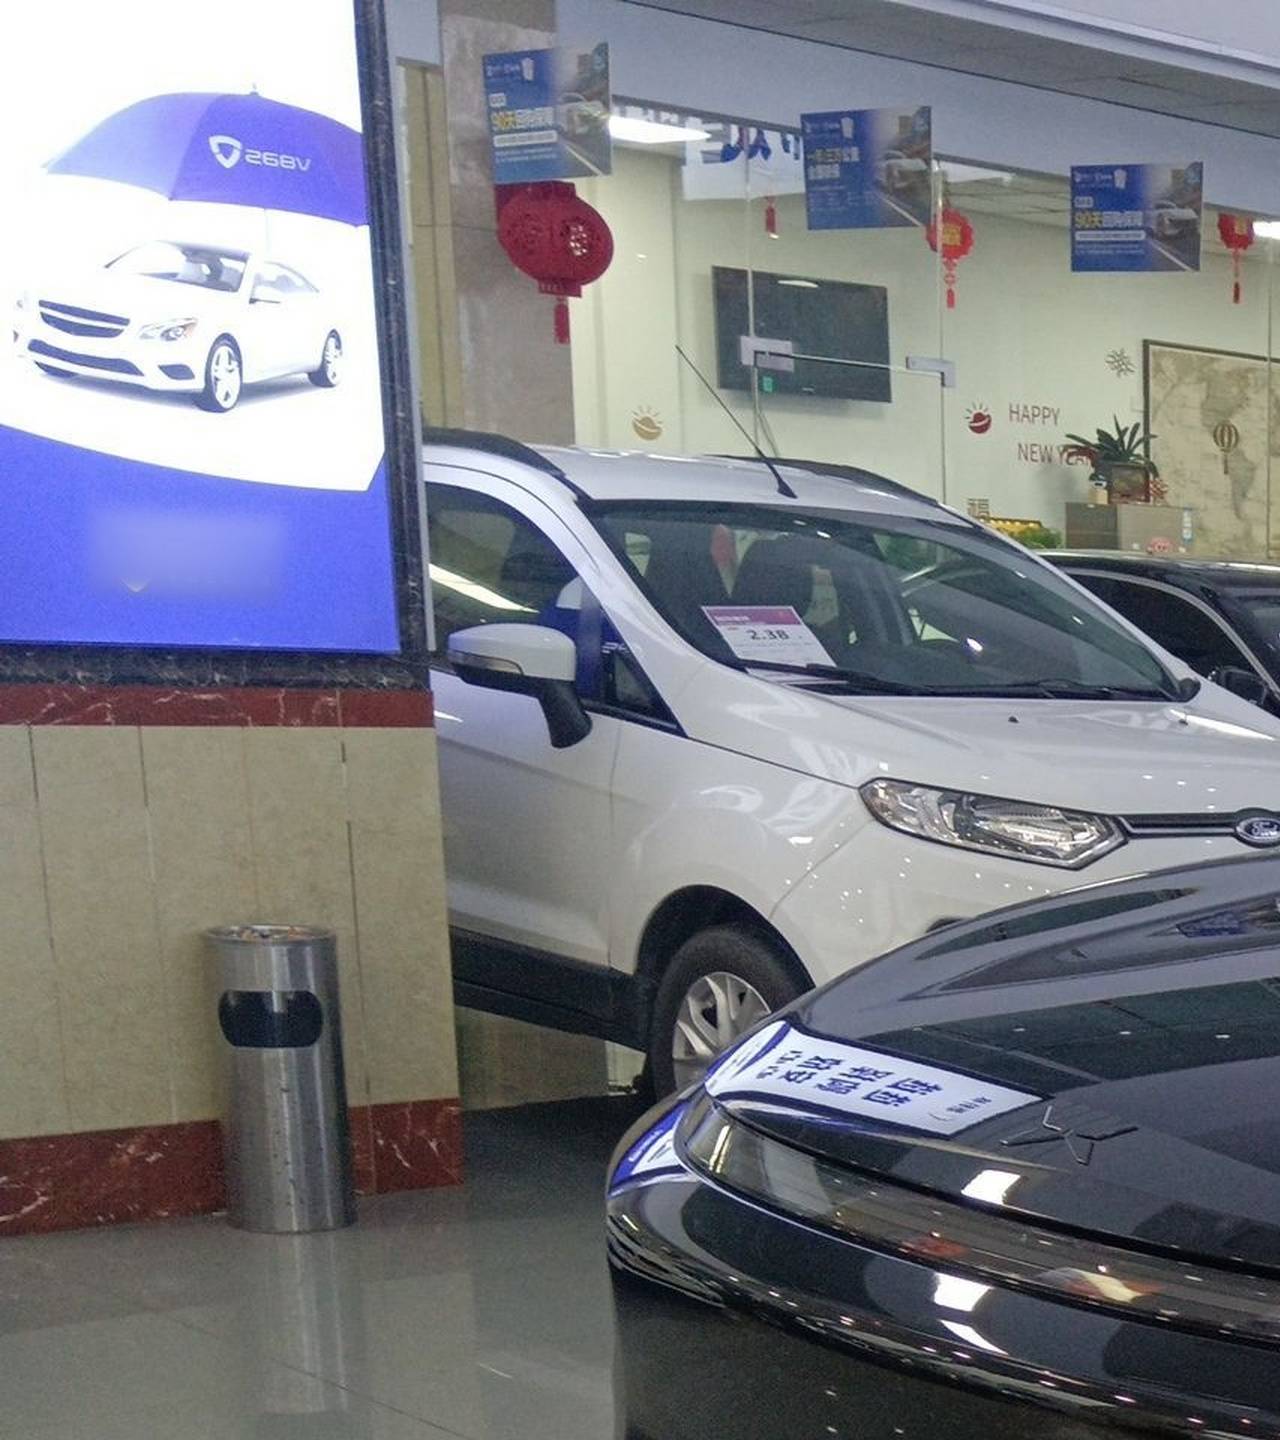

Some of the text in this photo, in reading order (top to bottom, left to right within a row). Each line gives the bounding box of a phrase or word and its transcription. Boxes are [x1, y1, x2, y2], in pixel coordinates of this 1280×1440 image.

[245, 148, 312, 172] 268V
[1008, 402, 1061, 427] HAPPY
[1018, 443, 1054, 464] NEW
[749, 629, 789, 641] 2.38
